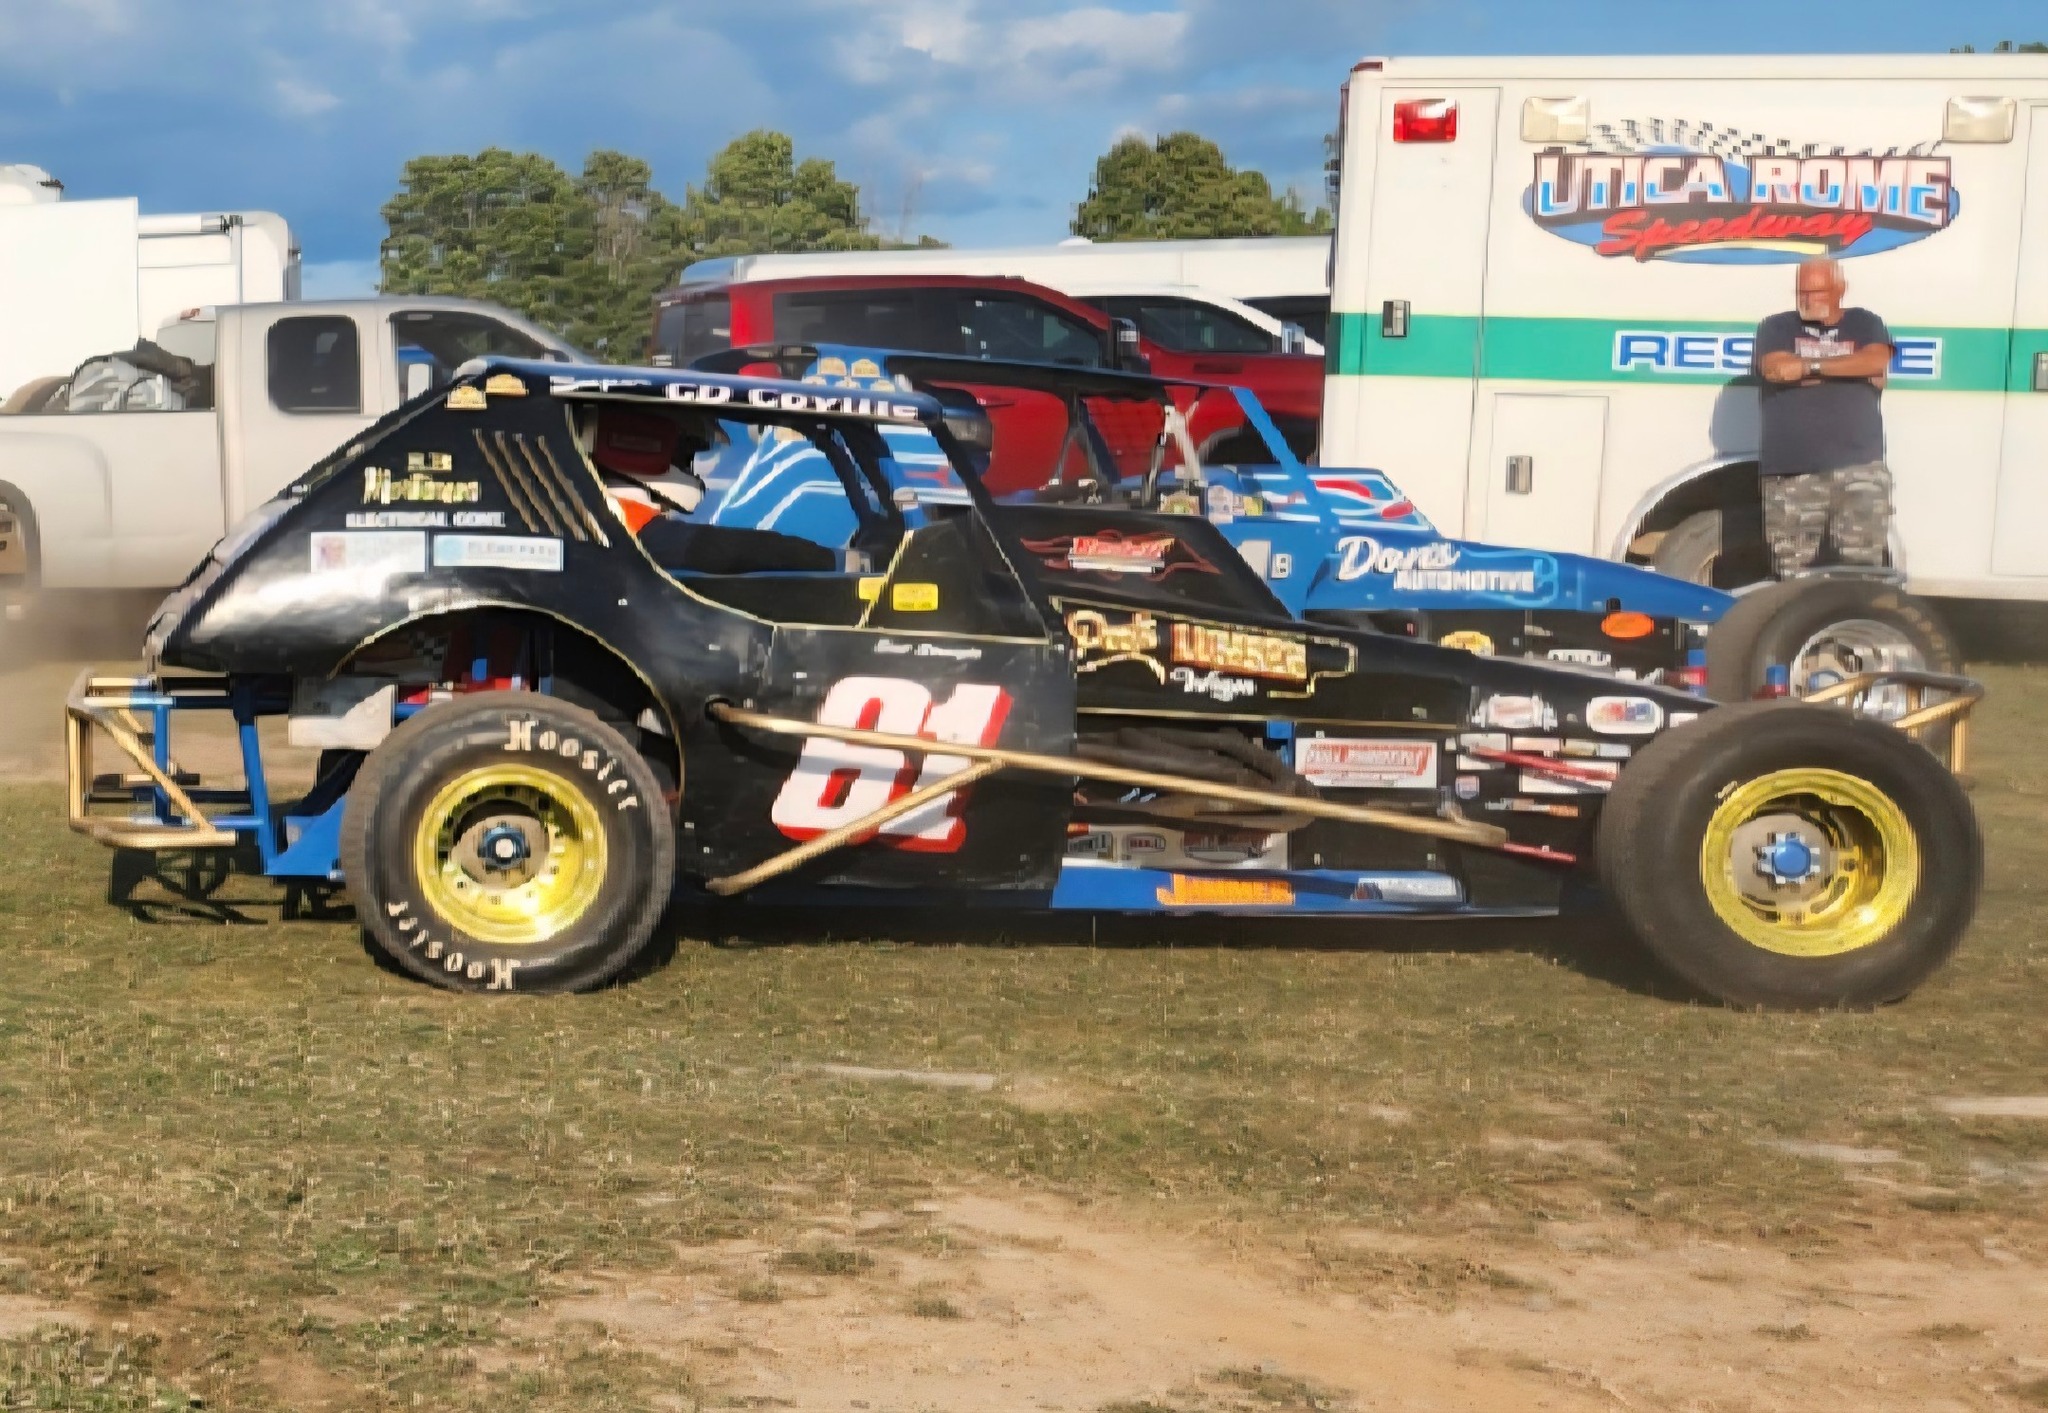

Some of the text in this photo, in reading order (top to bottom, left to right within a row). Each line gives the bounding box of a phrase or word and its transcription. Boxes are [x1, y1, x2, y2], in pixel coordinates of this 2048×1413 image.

[1534, 153, 1952, 228] UTICA ROME
[1595, 206, 1873, 262] Speedway
[1612, 330, 1943, 380] RESE
[504, 720, 638, 810] Hoosier
